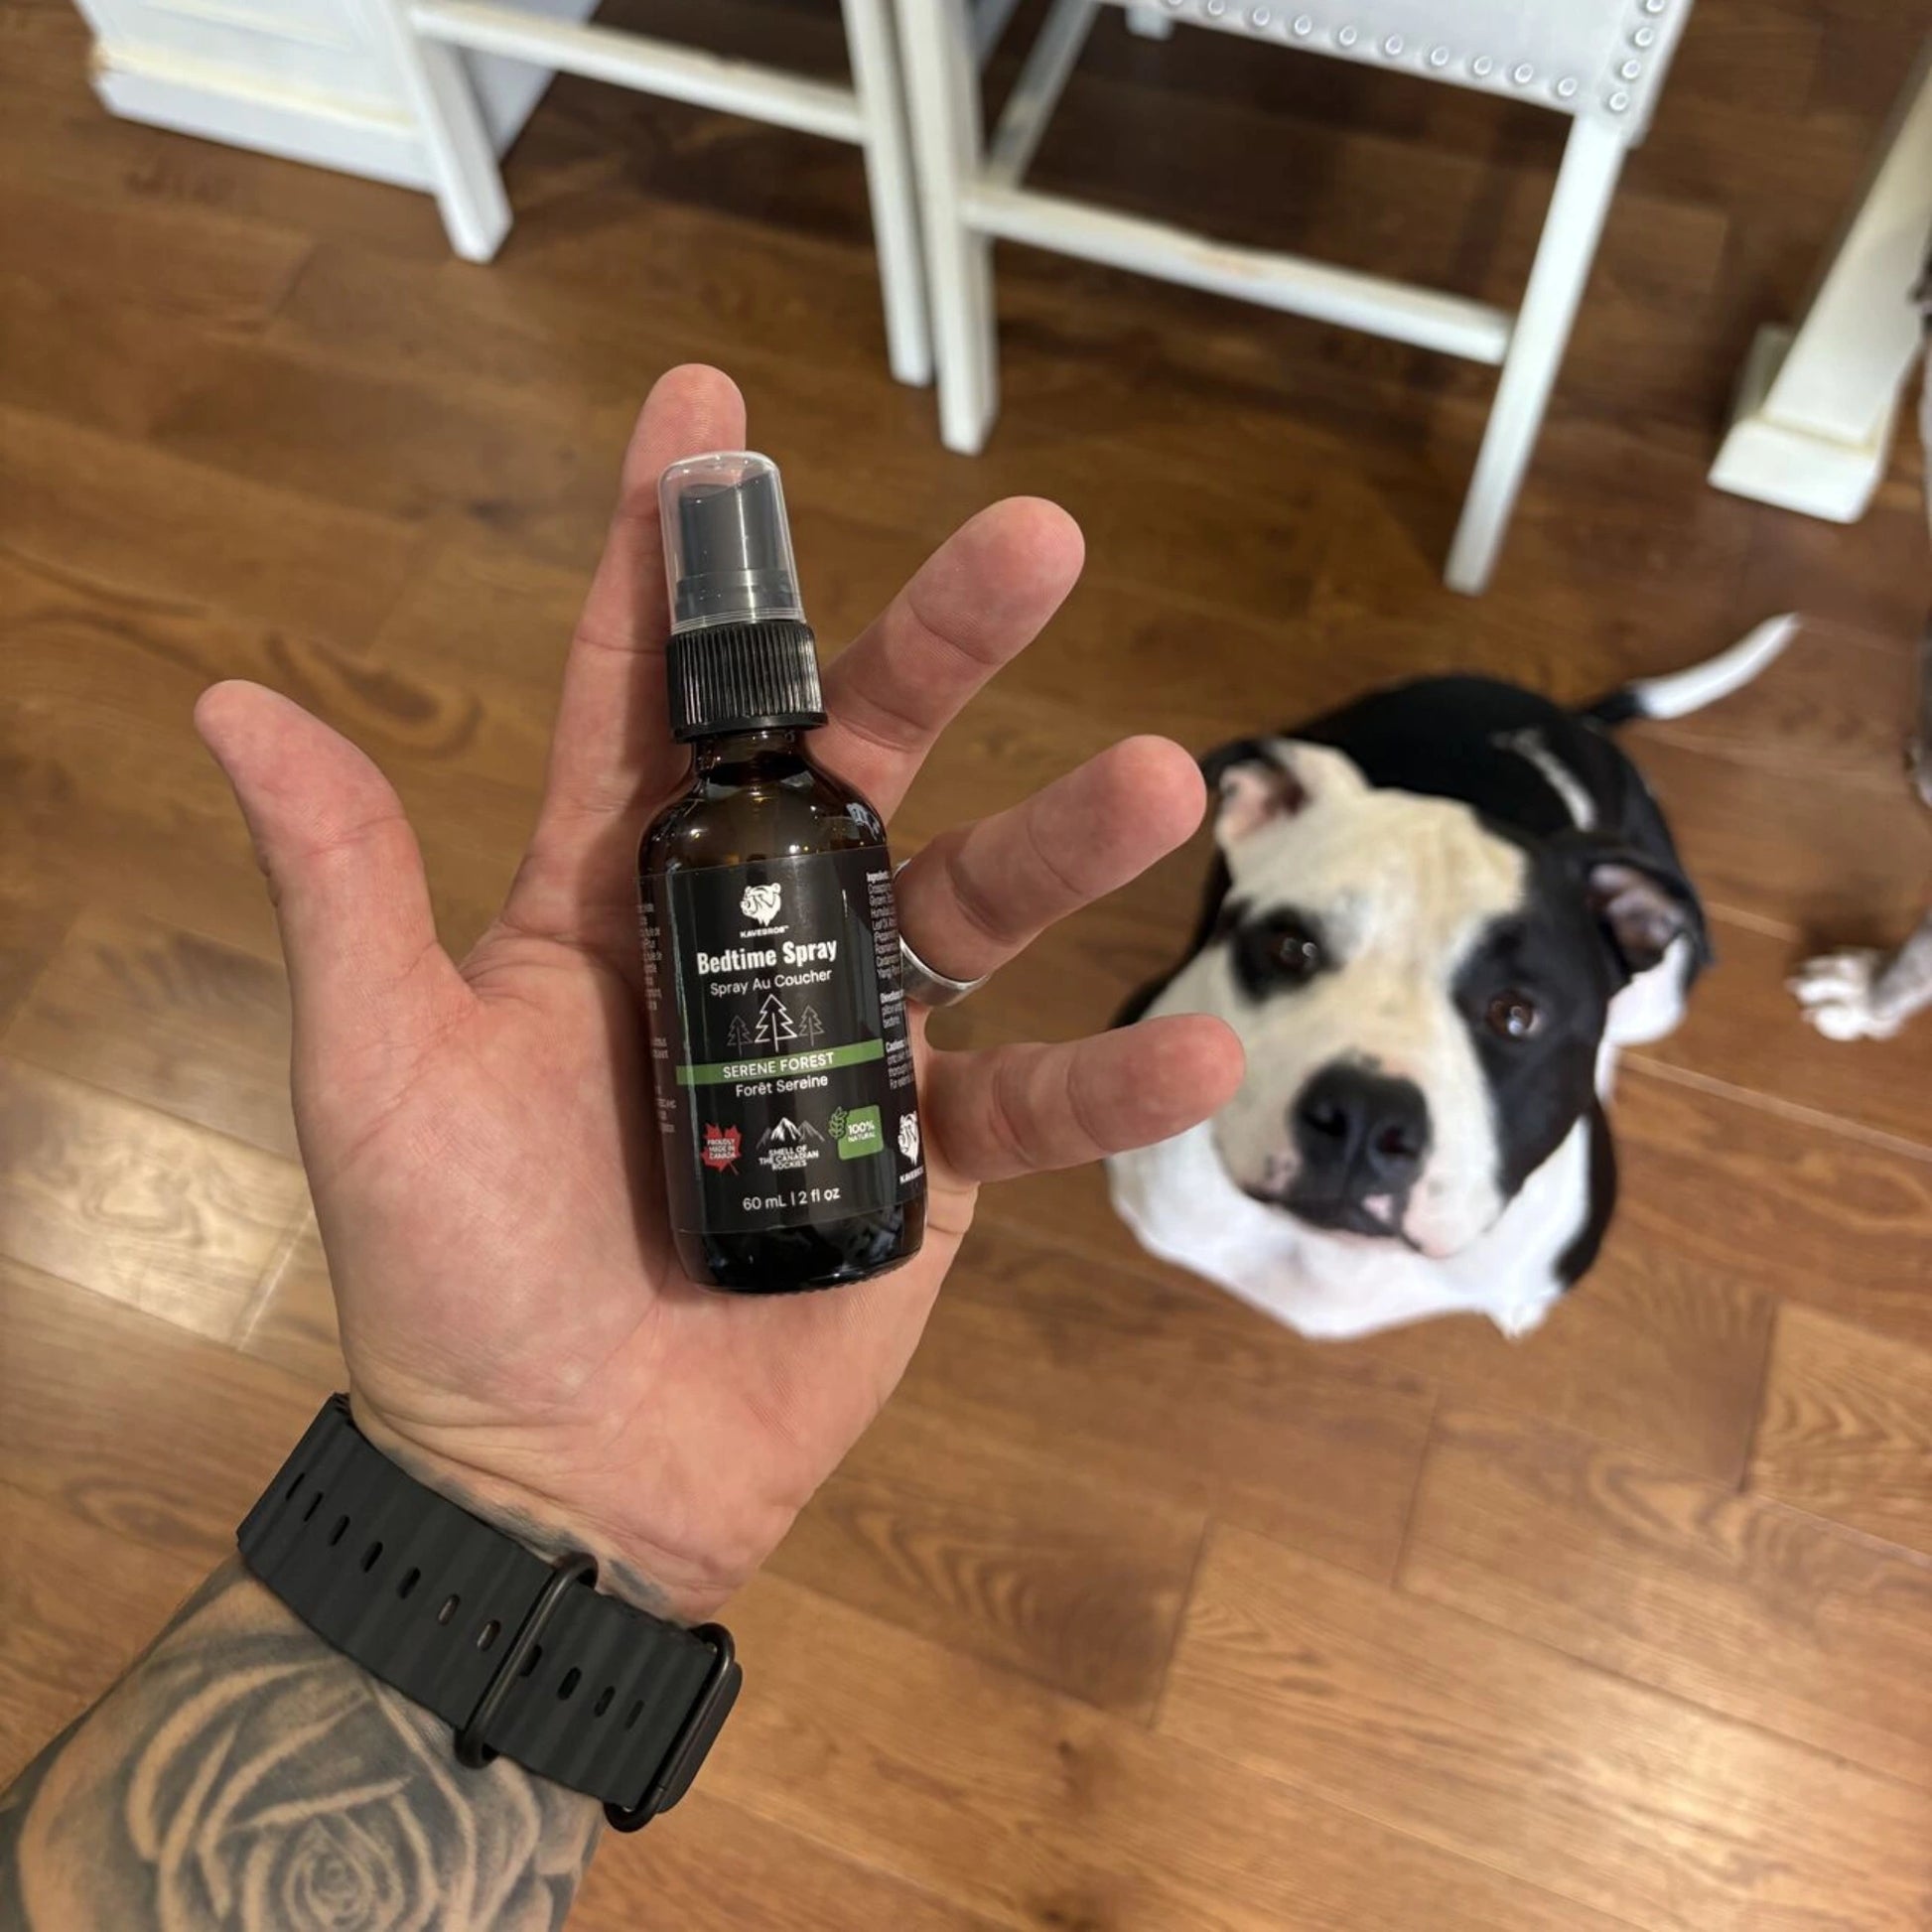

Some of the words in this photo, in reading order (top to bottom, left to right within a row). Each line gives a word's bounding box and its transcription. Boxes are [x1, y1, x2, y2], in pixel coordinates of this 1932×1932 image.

[696, 948, 777, 975] Bedtime
[782, 940, 838, 968] Spray
[710, 980, 749, 998] Spray
[753, 978, 771, 991] Au
[774, 969, 833, 988] Coucher
[723, 1060, 776, 1079] SERENE
[780, 1052, 834, 1071] FOREST
[736, 1081, 772, 1097] Forêt
[776, 1075, 829, 1093] Sereine
[848, 1120, 876, 1135] 100%
[759, 1157, 773, 1166] THE
[775, 1150, 819, 1163] CANADIAN
[743, 1196, 762, 1211] 60
[765, 1194, 786, 1209] mL
[798, 1190, 808, 1204] 2
[811, 1188, 820, 1202] fl
[824, 1187, 841, 1201] oz
